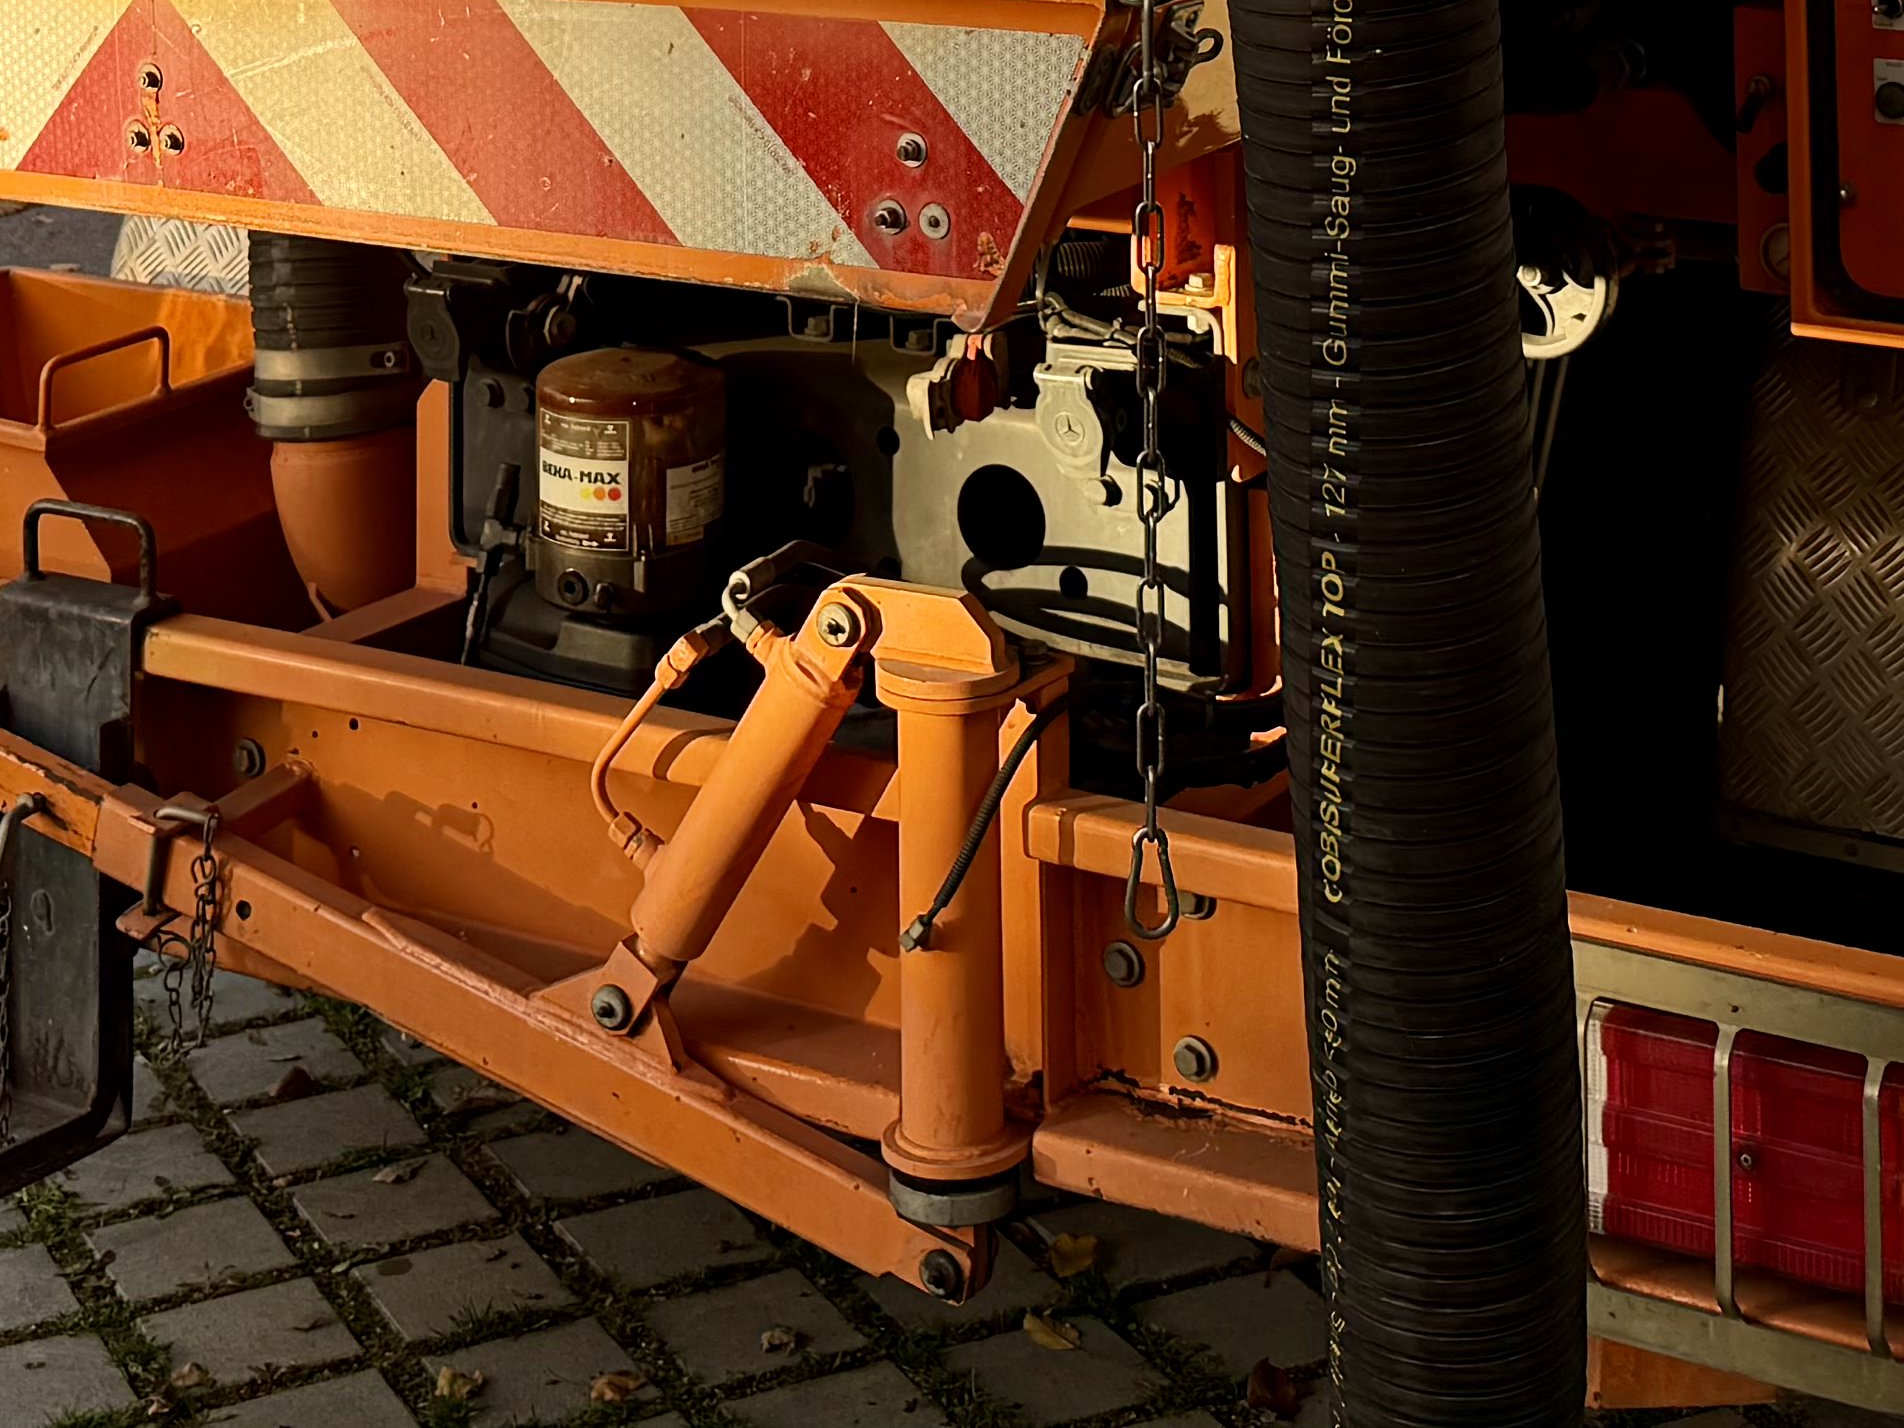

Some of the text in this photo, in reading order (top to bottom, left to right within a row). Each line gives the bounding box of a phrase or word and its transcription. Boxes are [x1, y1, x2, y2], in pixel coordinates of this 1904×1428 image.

[1331, 77, 1351, 133] und
[1322, 145, 1356, 366] Gummi-Saug-
[1322, 551, 1346, 617] TOP
